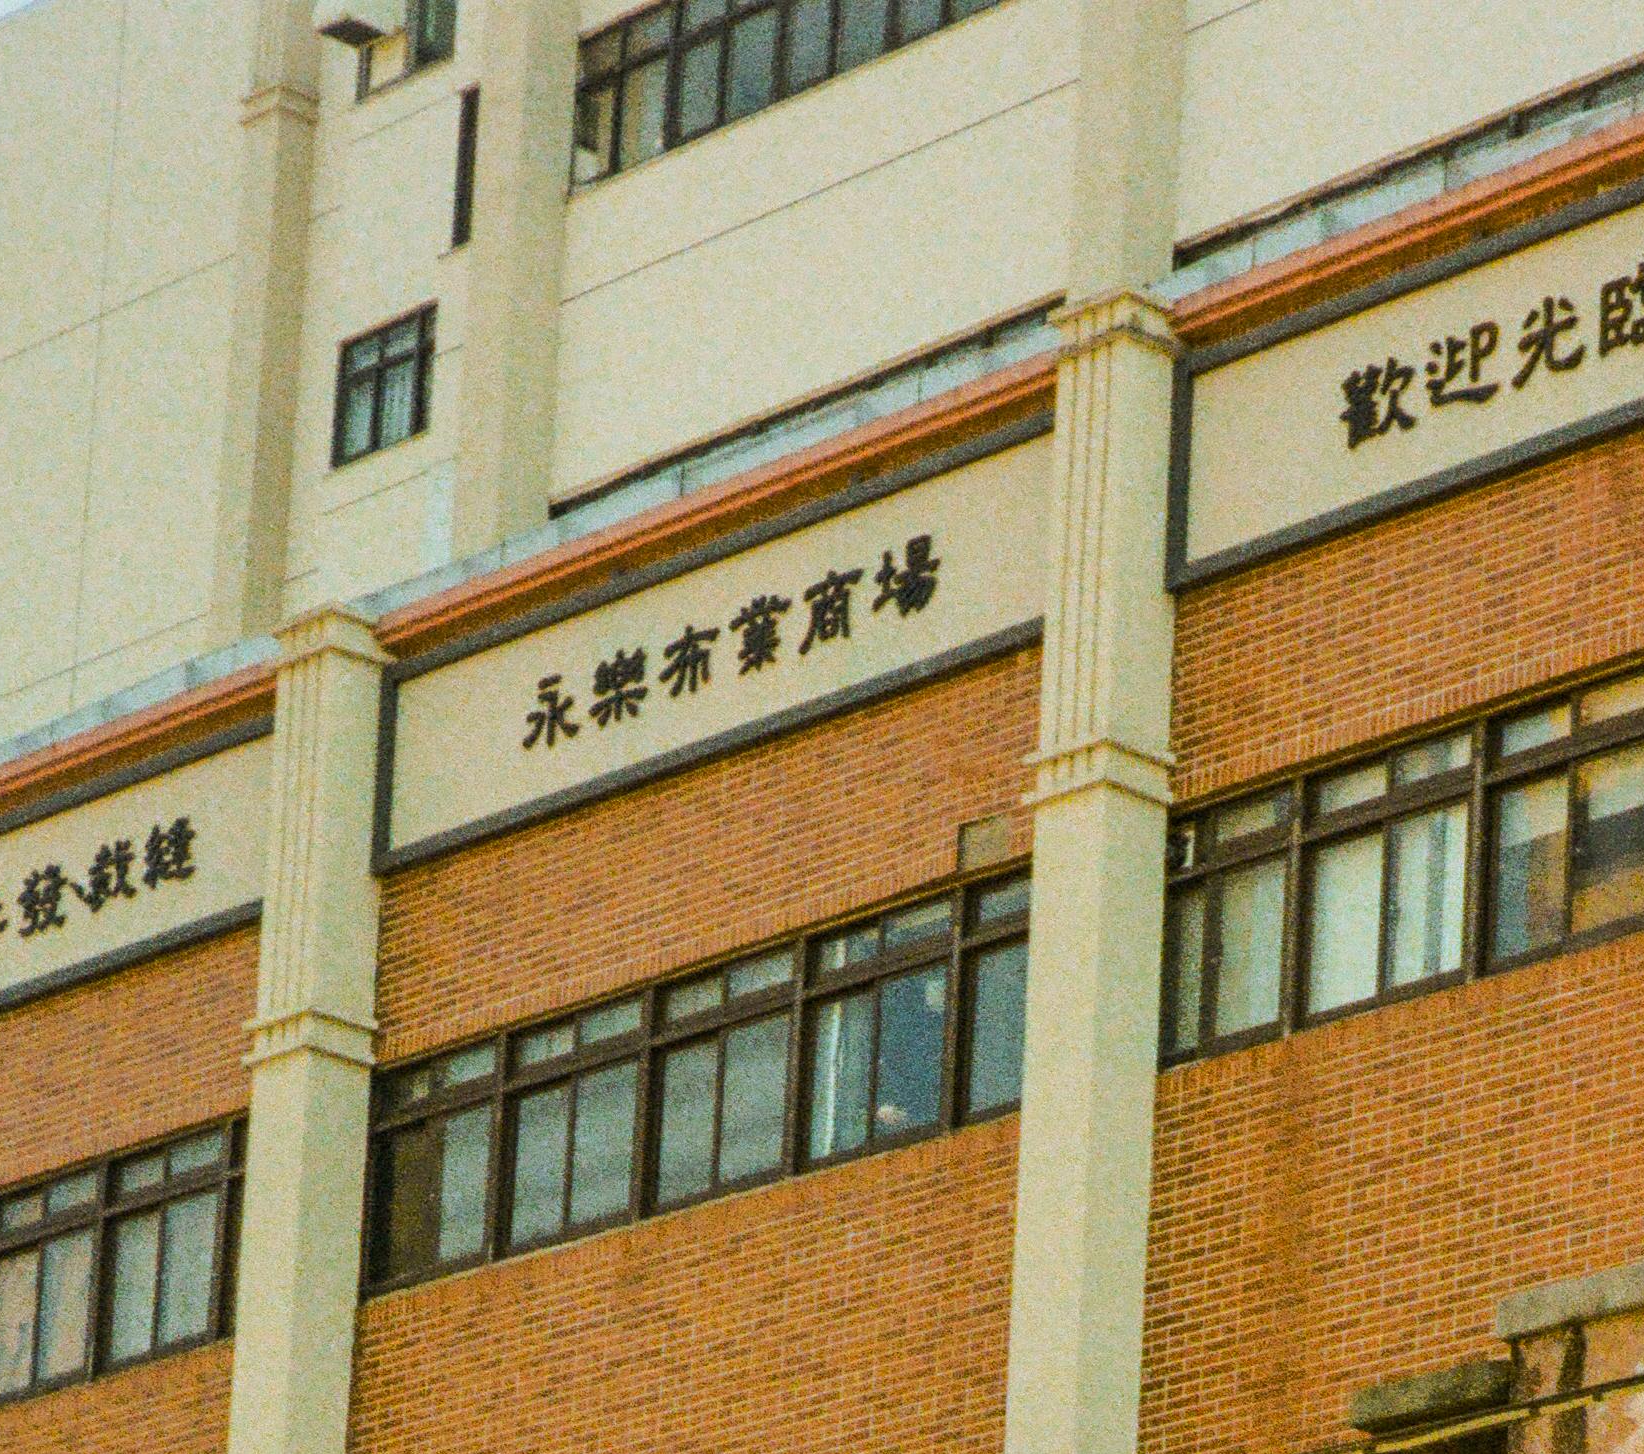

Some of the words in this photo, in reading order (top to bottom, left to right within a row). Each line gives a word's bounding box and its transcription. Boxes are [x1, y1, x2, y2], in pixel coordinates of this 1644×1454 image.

[522, 534, 942, 750] 永樂布業商場
